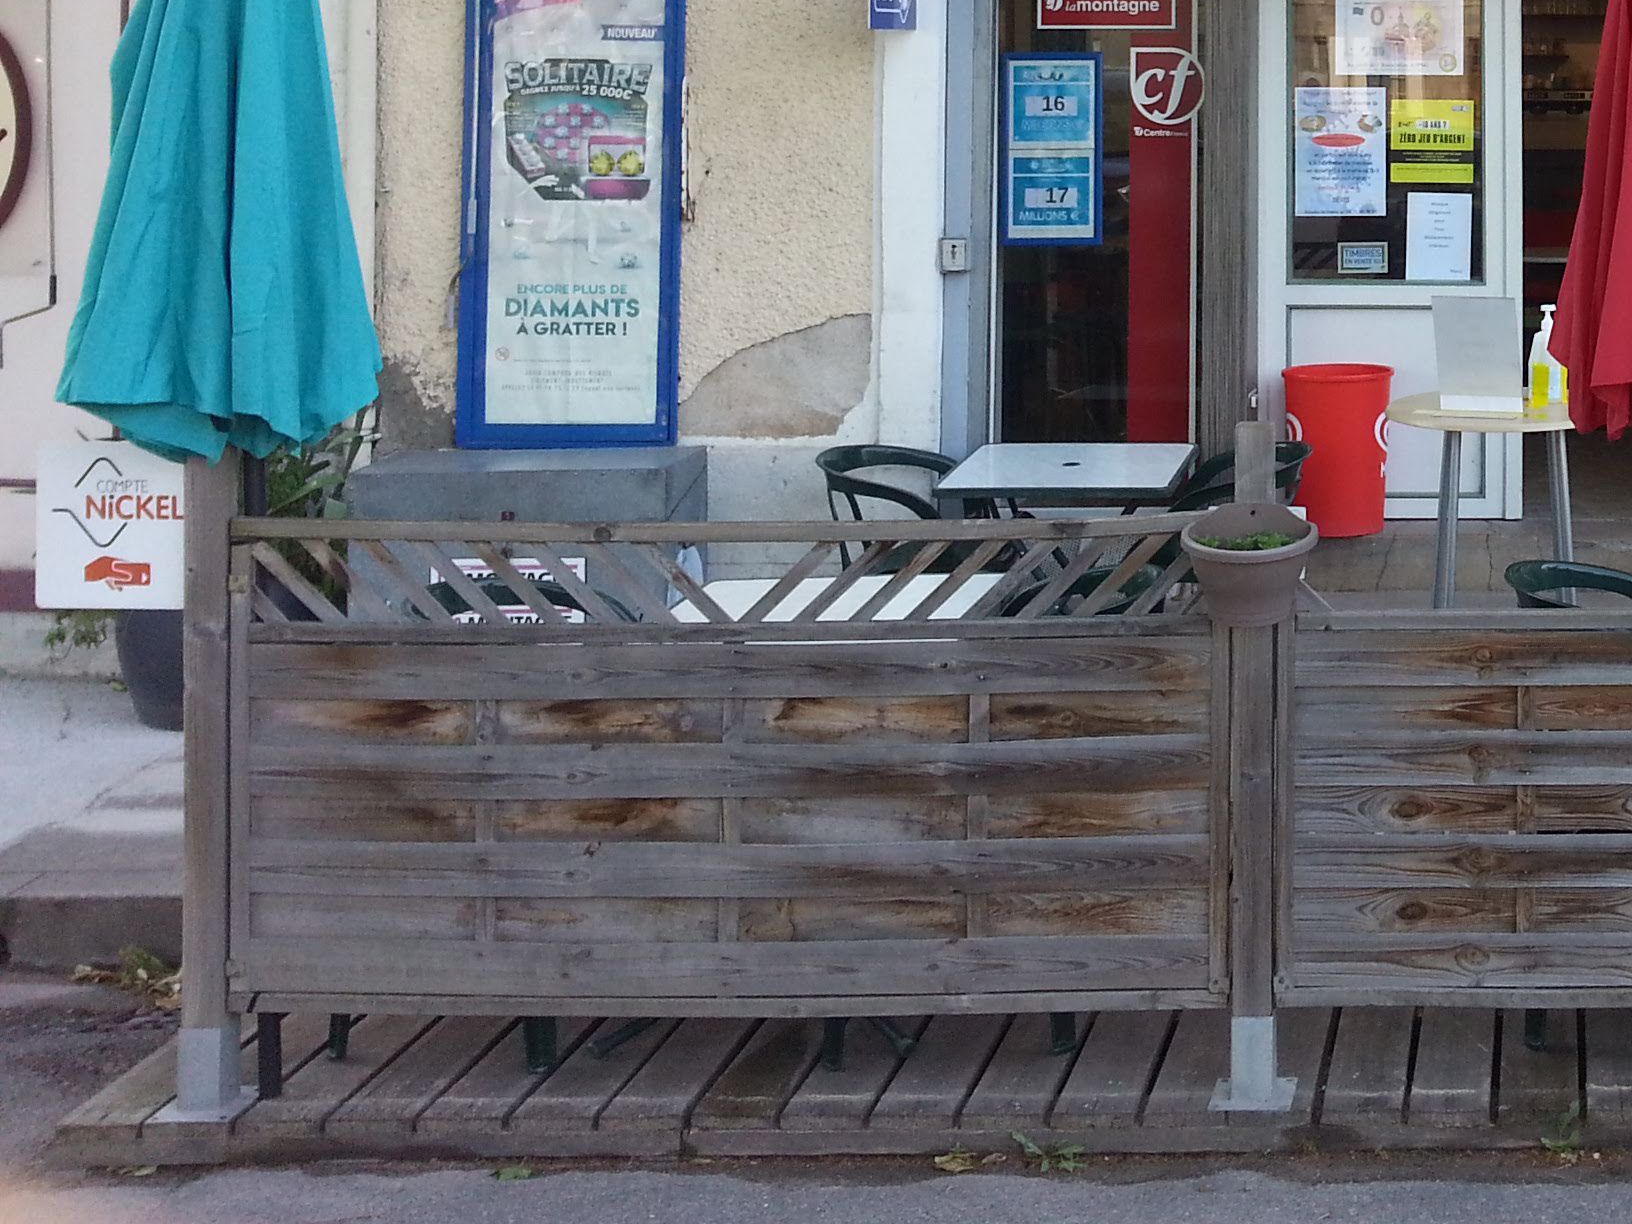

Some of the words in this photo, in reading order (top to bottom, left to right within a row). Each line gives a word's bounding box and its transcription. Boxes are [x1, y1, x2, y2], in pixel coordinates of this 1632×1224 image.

[504, 62, 652, 94] SOLITAIRE
[581, 85, 598, 96] 25
[1042, 95, 1065, 112] 16
[1045, 187, 1069, 204] 17
[516, 283, 569, 295] ENCORE
[573, 284, 606, 295] PLUS
[610, 284, 628, 295] DE
[504, 297, 641, 318] DIAMANTS
[516, 317, 529, 336] À
[534, 321, 617, 337] GRATTER
[96, 479, 149, 494] COMPTE
